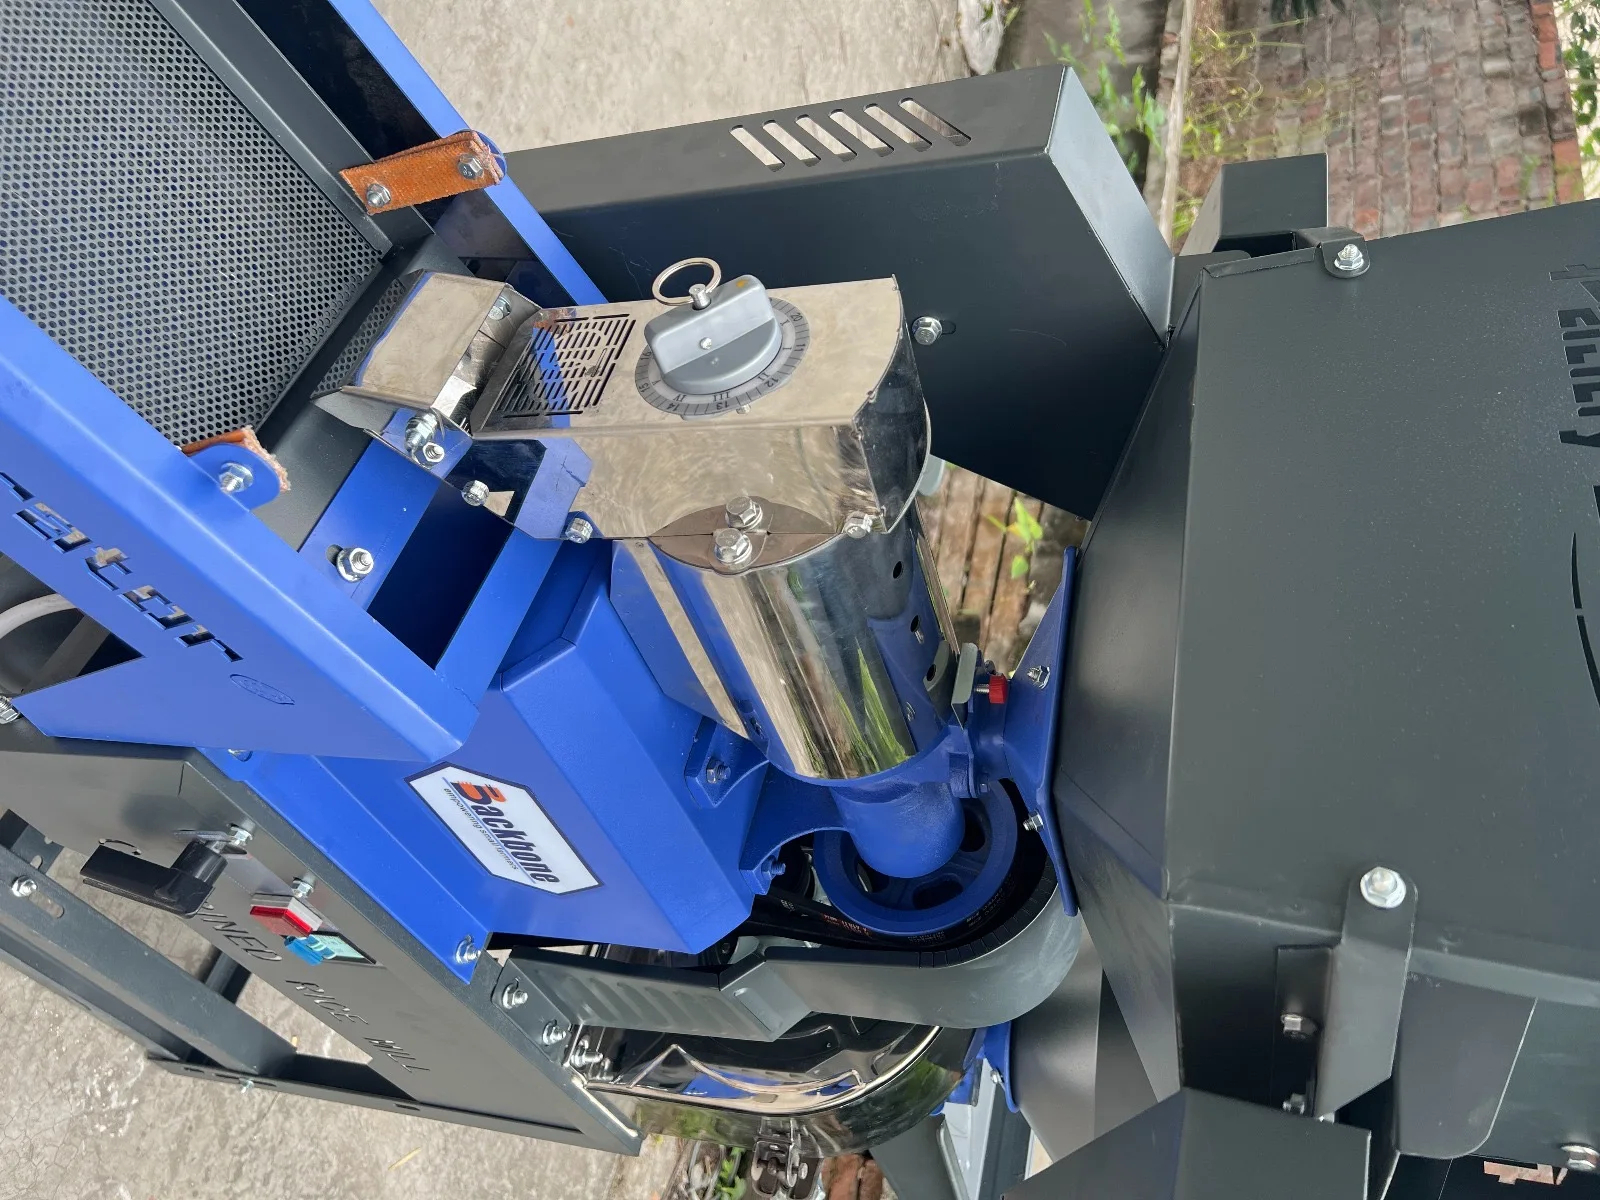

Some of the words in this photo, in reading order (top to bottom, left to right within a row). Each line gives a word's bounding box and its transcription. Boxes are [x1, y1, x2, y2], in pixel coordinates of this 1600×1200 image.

[790, 312, 803, 321] 20
[794, 343, 806, 352] 11
[638, 382, 649, 393] 15
[764, 377, 779, 388] 12
[713, 391, 730, 402] III
[666, 402, 680, 412] 14
[716, 401, 730, 410] 13
[443, 787, 482, 829] empowering
[479, 828, 499, 851] small
[450, 781, 561, 883] Backbone
[285, 979, 370, 1025] RICE
[362, 1036, 431, 1073] MILL
